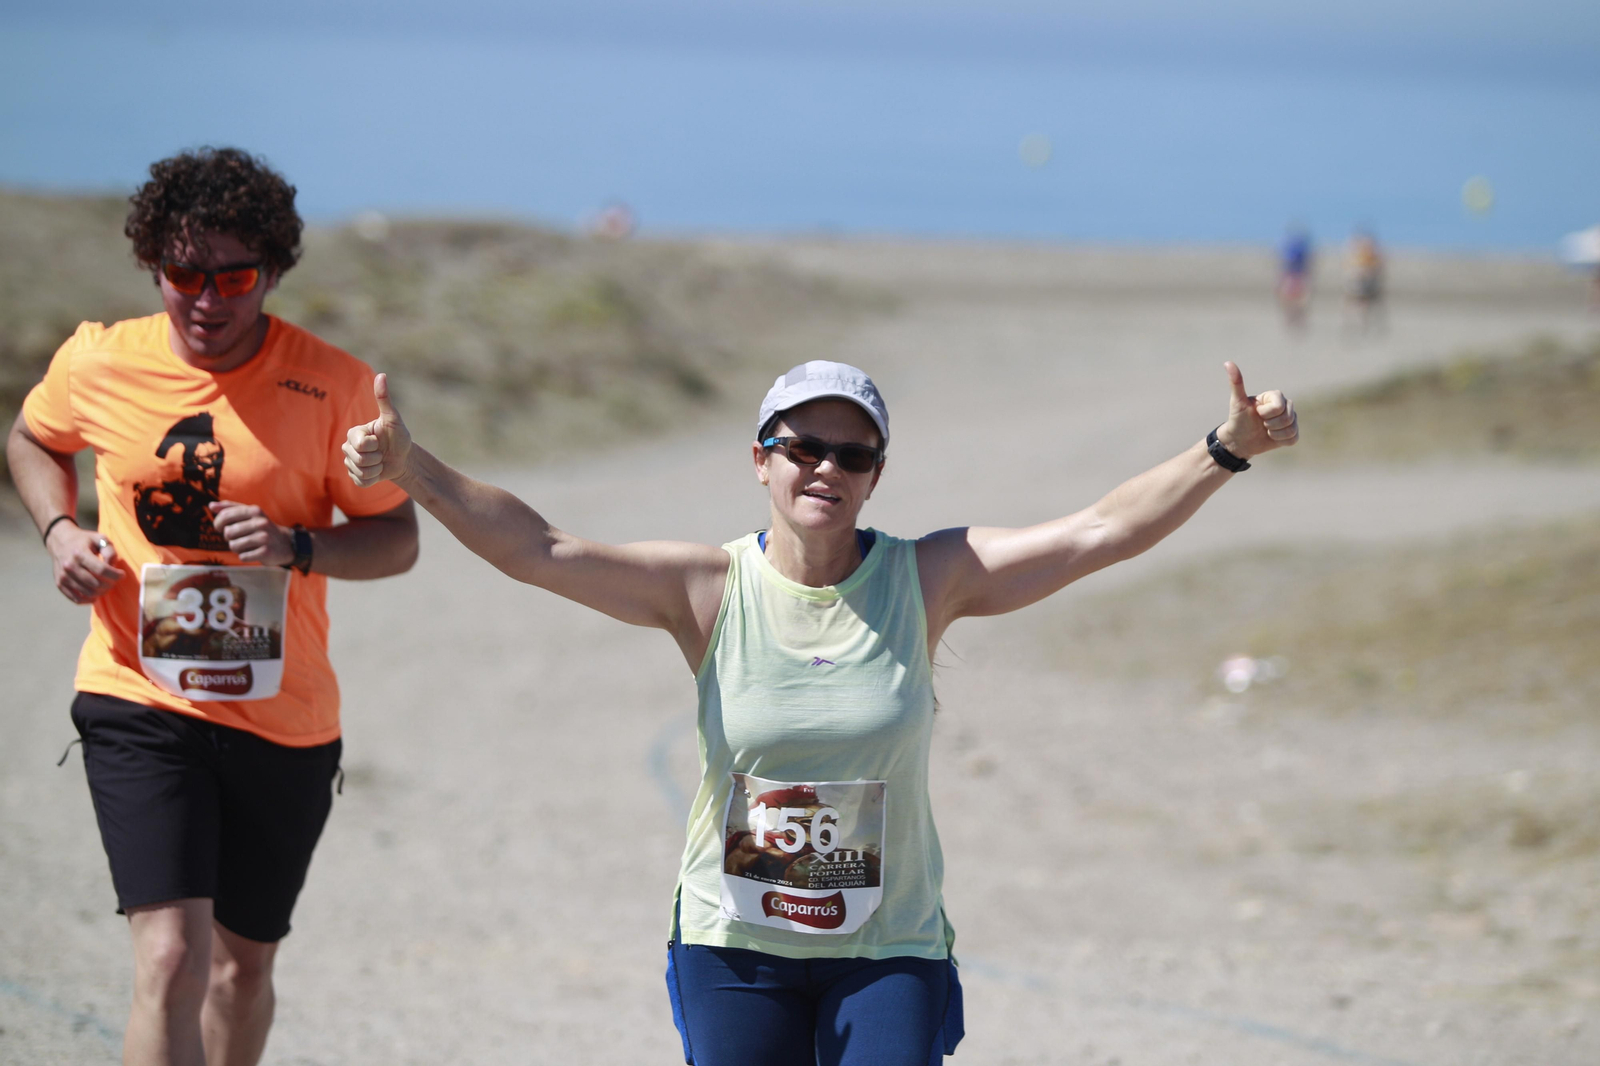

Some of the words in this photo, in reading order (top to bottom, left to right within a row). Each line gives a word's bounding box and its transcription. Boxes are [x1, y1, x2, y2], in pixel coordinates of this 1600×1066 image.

[176, 587, 235, 631] 38
[749, 802, 839, 854] 156
[810, 850, 866, 864] XIII
[809, 862, 866, 871] CARRERA
[809, 869, 865, 877] POPULAR
